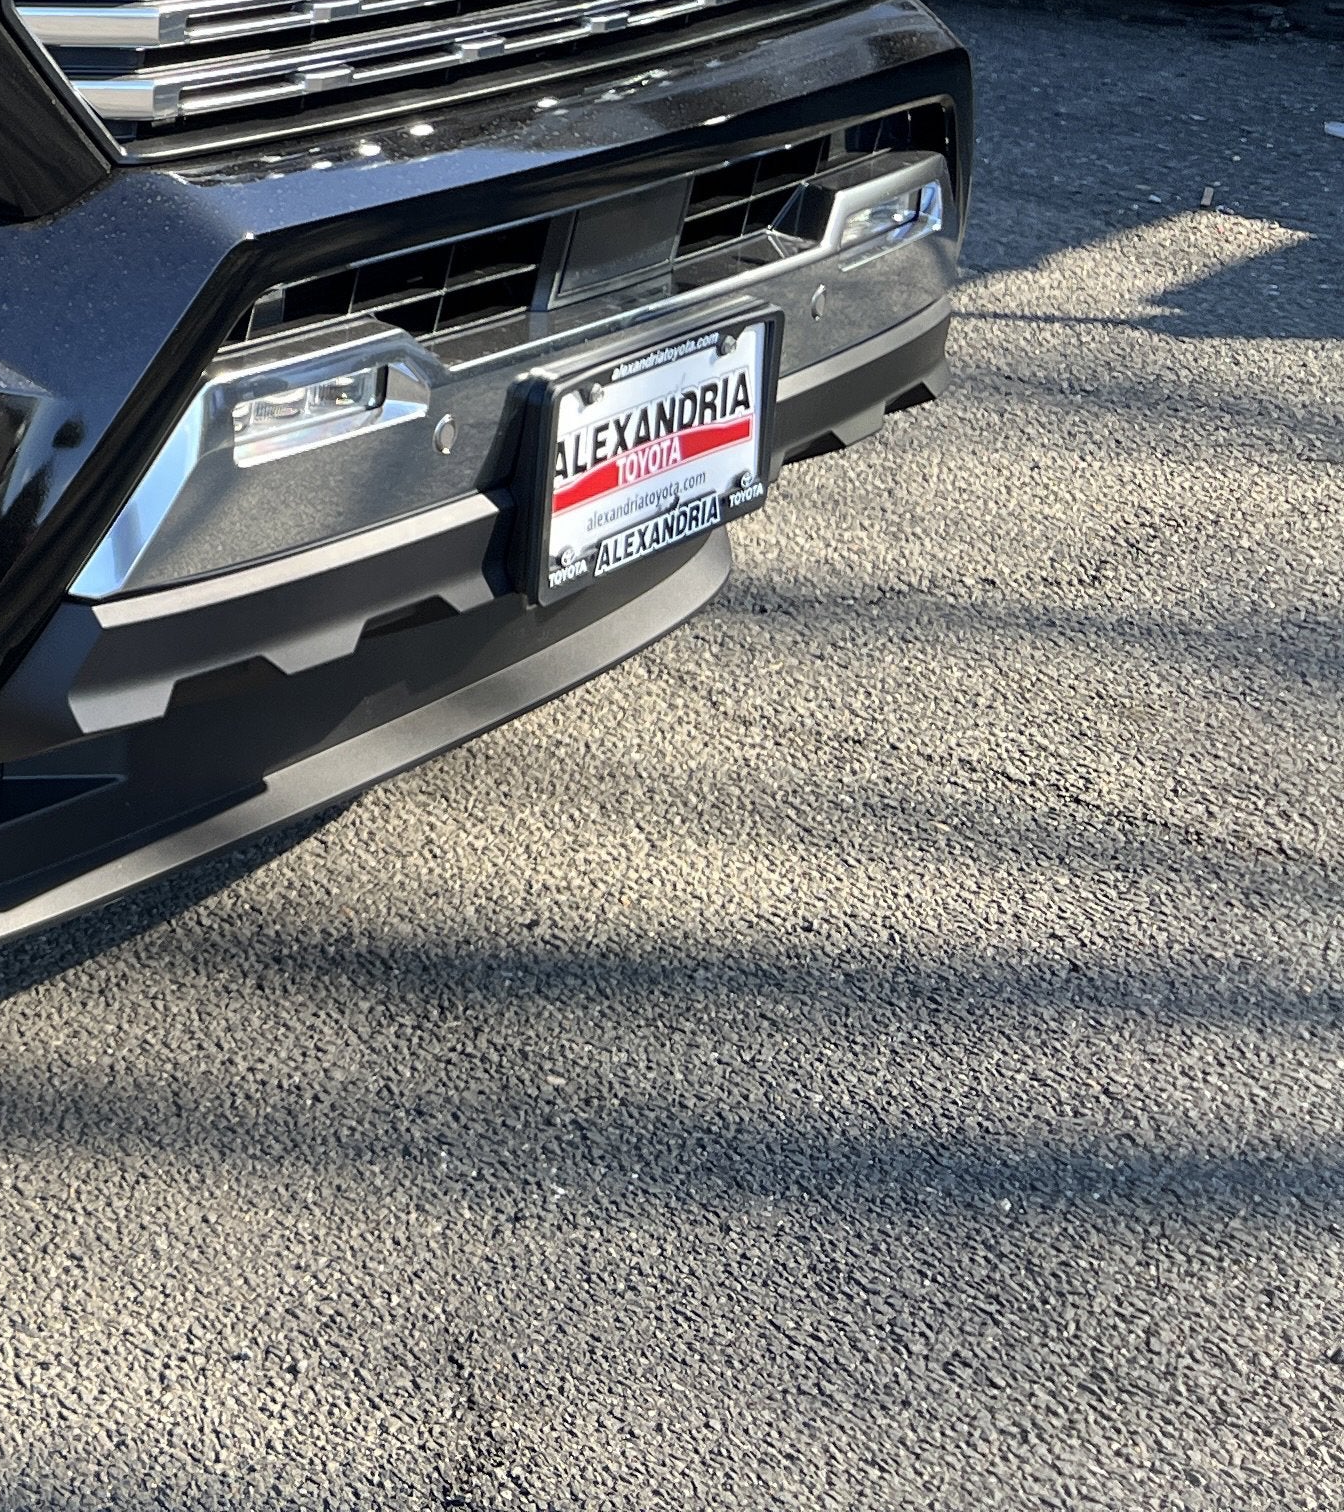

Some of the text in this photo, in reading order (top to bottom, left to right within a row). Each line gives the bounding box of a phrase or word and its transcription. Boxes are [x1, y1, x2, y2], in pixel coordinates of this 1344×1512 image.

[611, 332, 719, 381] alexandriatoyota.com
[554, 371, 750, 480] ALEXANDRIA
[616, 436, 681, 488] TOYOTA
[586, 472, 706, 532] alexandriatoyota.com
[548, 482, 764, 588] TOYOTA ALEXANDRIA TOYOTA
